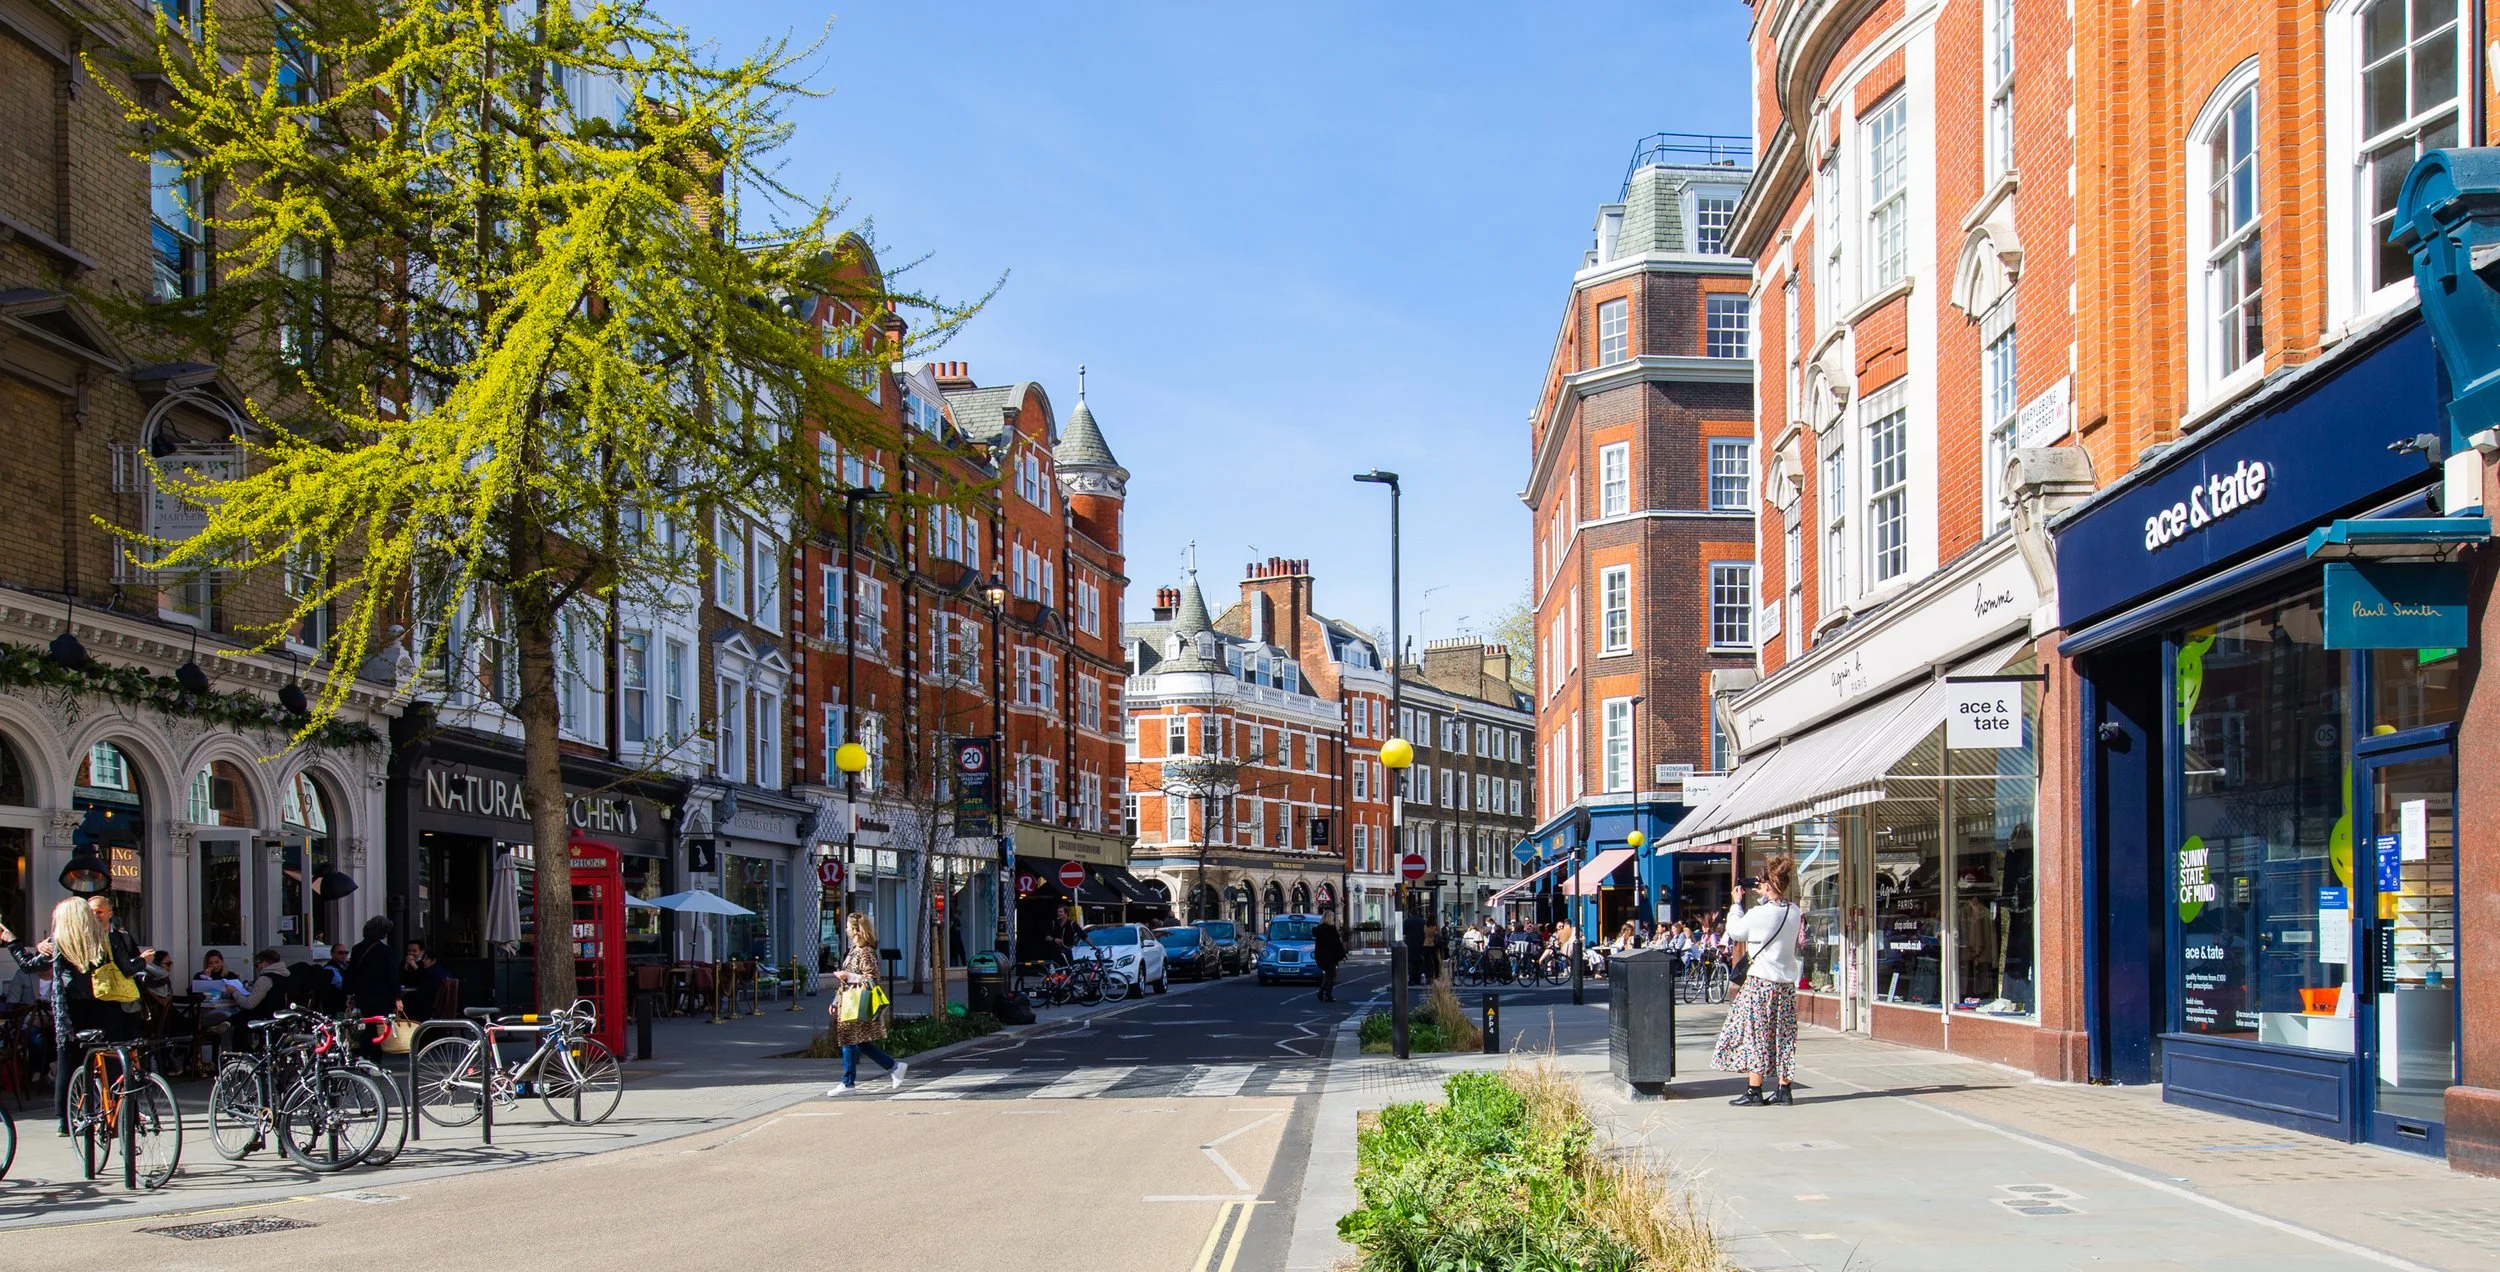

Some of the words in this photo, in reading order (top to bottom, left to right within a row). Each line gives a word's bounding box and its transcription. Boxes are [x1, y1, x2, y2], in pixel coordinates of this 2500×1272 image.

[2021, 390, 2057, 427] MARYLEBONE
[2021, 426, 2034, 440] HIGH
[2035, 408, 2055, 433] STREET
[2144, 502, 2188, 551] ace
[2190, 485, 2212, 529] &
[2208, 460, 2266, 518] tate
[2352, 600, 2388, 618] Paul
[2393, 602, 2445, 617] Smith
[1959, 702, 1991, 714] ace
[1996, 699, 2009, 713] &
[1973, 716, 2010, 731] tate
[963, 751, 981, 764] 20
[426, 768, 532, 820] NATURA
[2180, 847, 2209, 868] SUNNY
[2180, 867, 2205, 886] STATE
[2180, 885, 2193, 904] OF
[2194, 883, 2216, 903] MIND
[1897, 899, 1914, 910] PARIS
[2185, 947, 2200, 960] ace
[2200, 945, 2208, 960] &
[2207, 945, 2224, 960] tate
[516, 1085, 523, 1094] P
